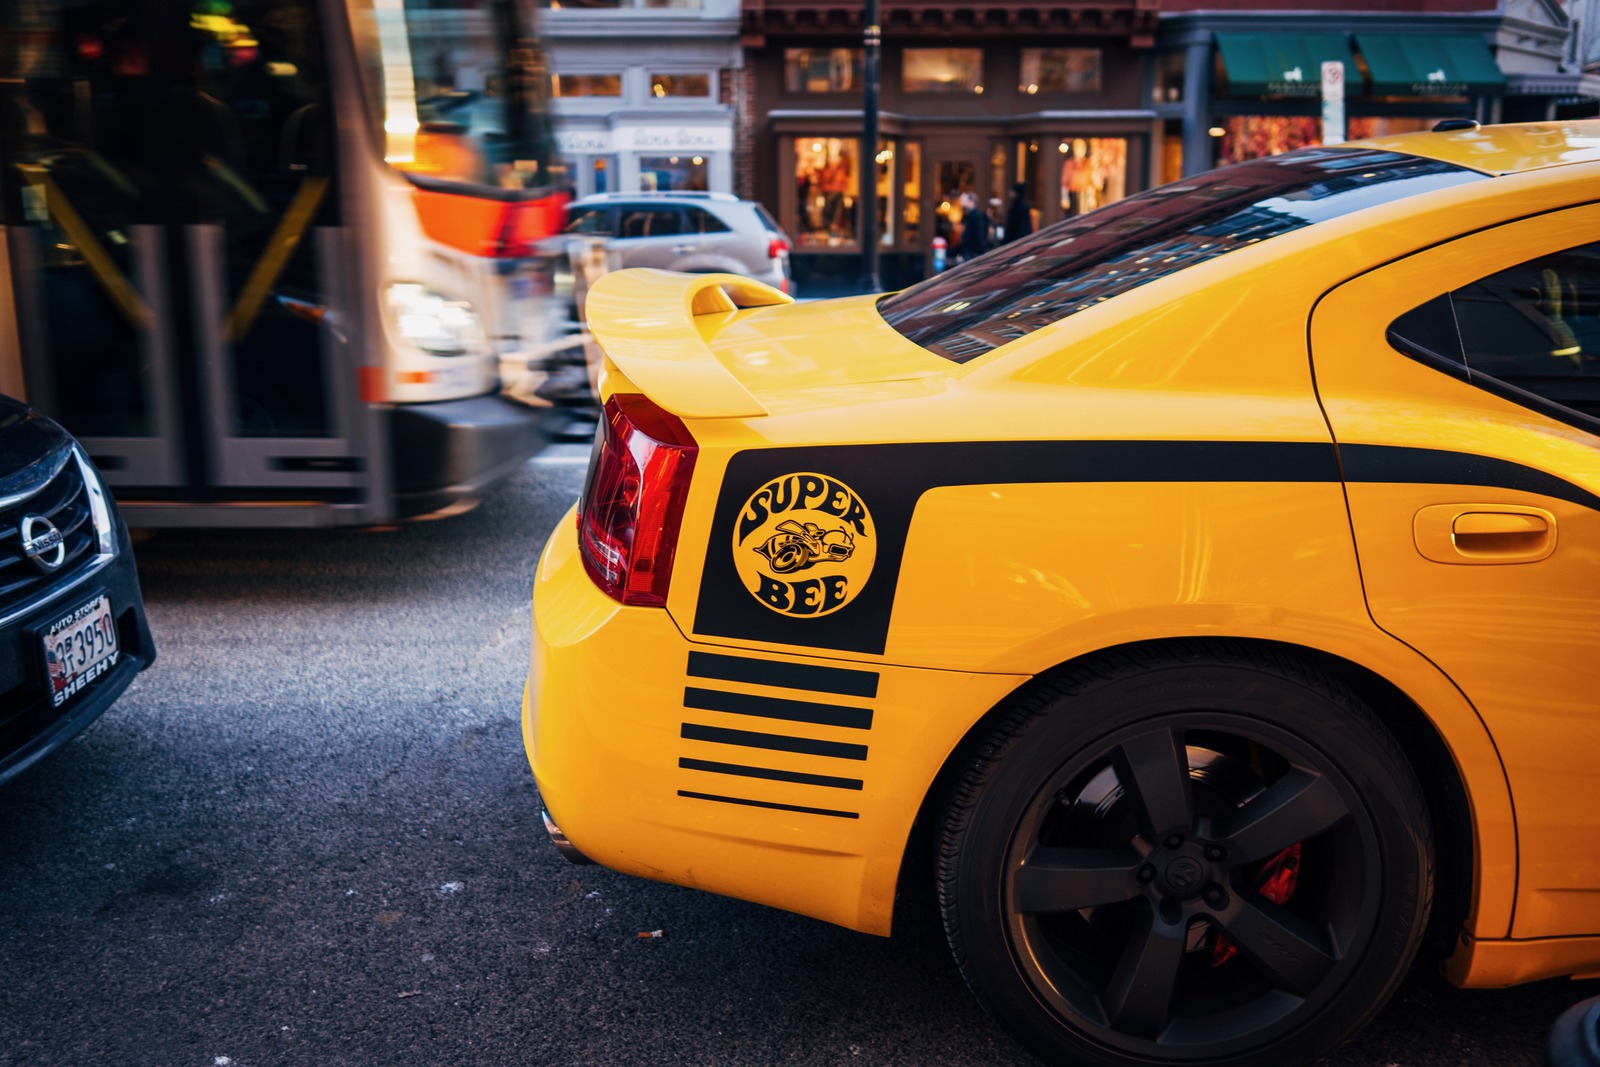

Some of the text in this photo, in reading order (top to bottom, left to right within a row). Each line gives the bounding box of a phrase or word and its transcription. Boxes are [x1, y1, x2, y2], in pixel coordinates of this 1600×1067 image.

[739, 475, 868, 547] SUPER
[50, 614, 73, 634] AUTO
[74, 594, 104, 618] STORES
[754, 572, 848, 614] BEE
[54, 651, 119, 707] SHEEHY
